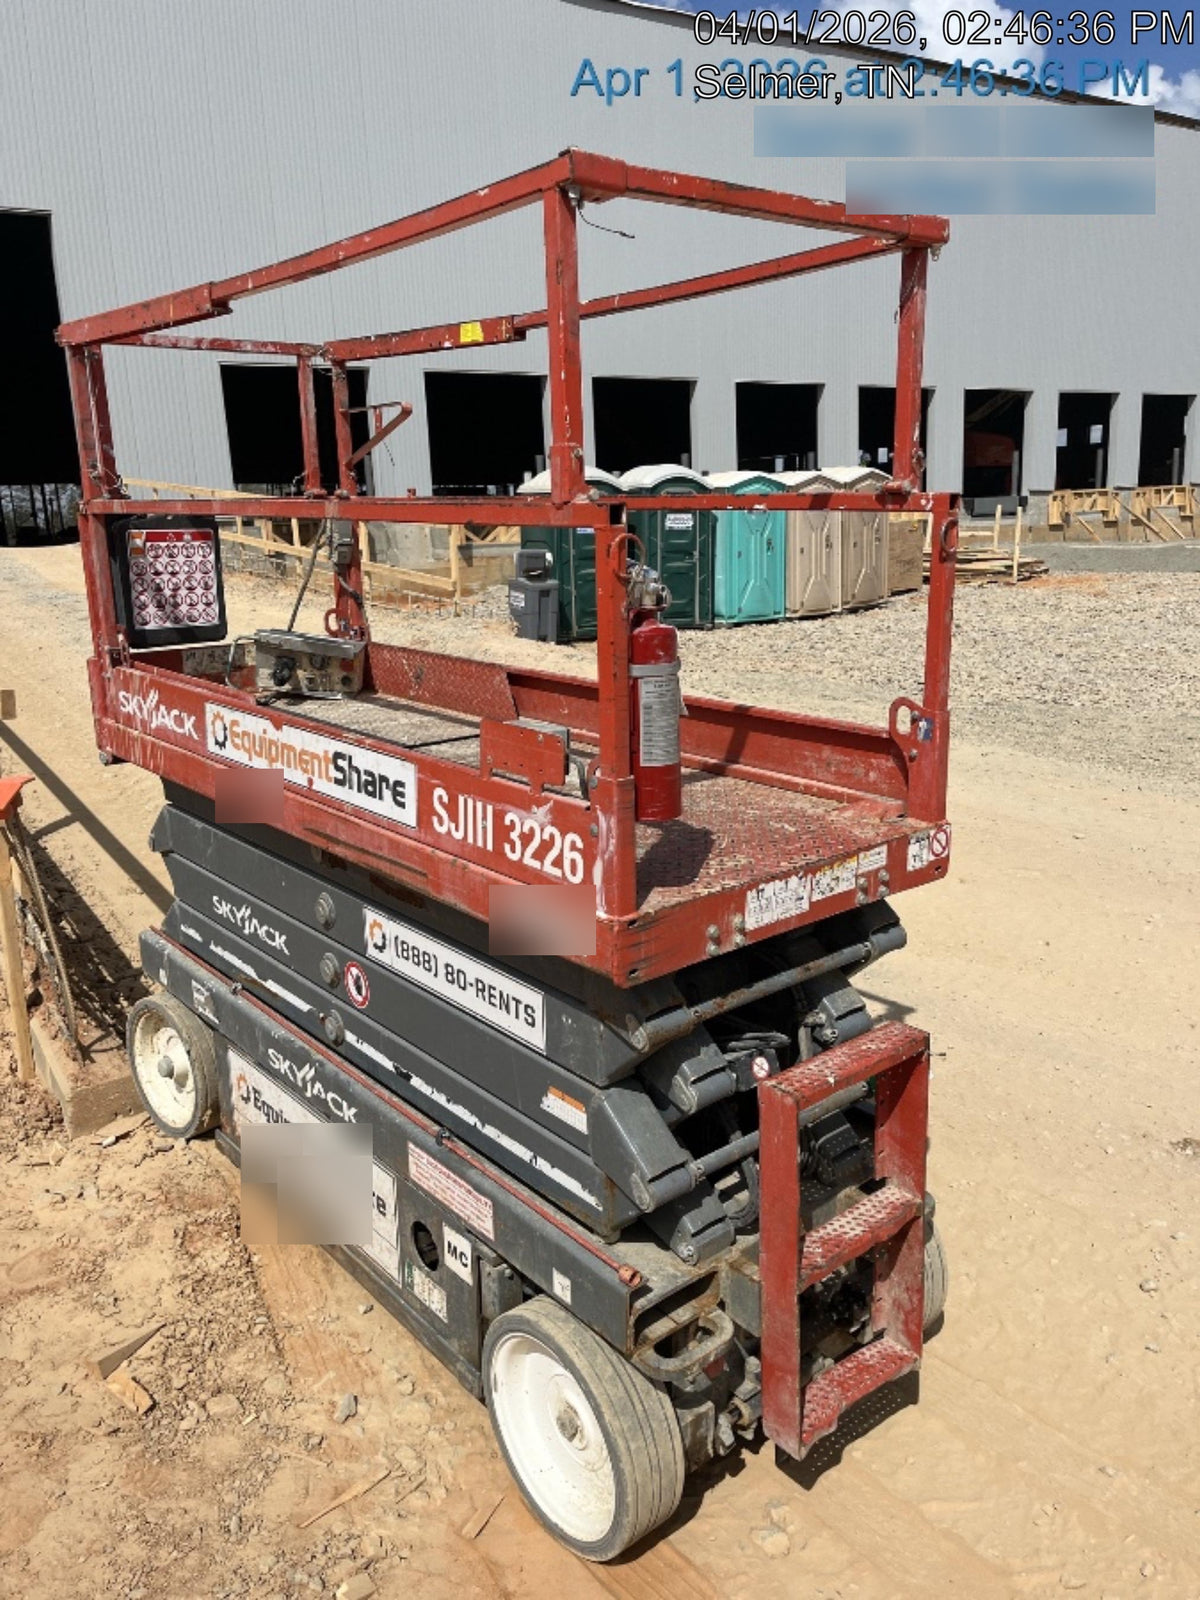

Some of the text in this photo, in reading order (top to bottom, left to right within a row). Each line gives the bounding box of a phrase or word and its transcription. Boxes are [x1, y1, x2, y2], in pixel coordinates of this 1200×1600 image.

[118, 687, 200, 741] SKYJACK
[229, 719, 406, 810] EquipmentShare
[504, 812, 584, 884] 3226
[212, 895, 291, 956] SKYJACK
[394, 934, 537, 1028] (888) 80-RENTS
[267, 1048, 358, 1123] SKYJACK
[447, 1240, 469, 1269] MC
